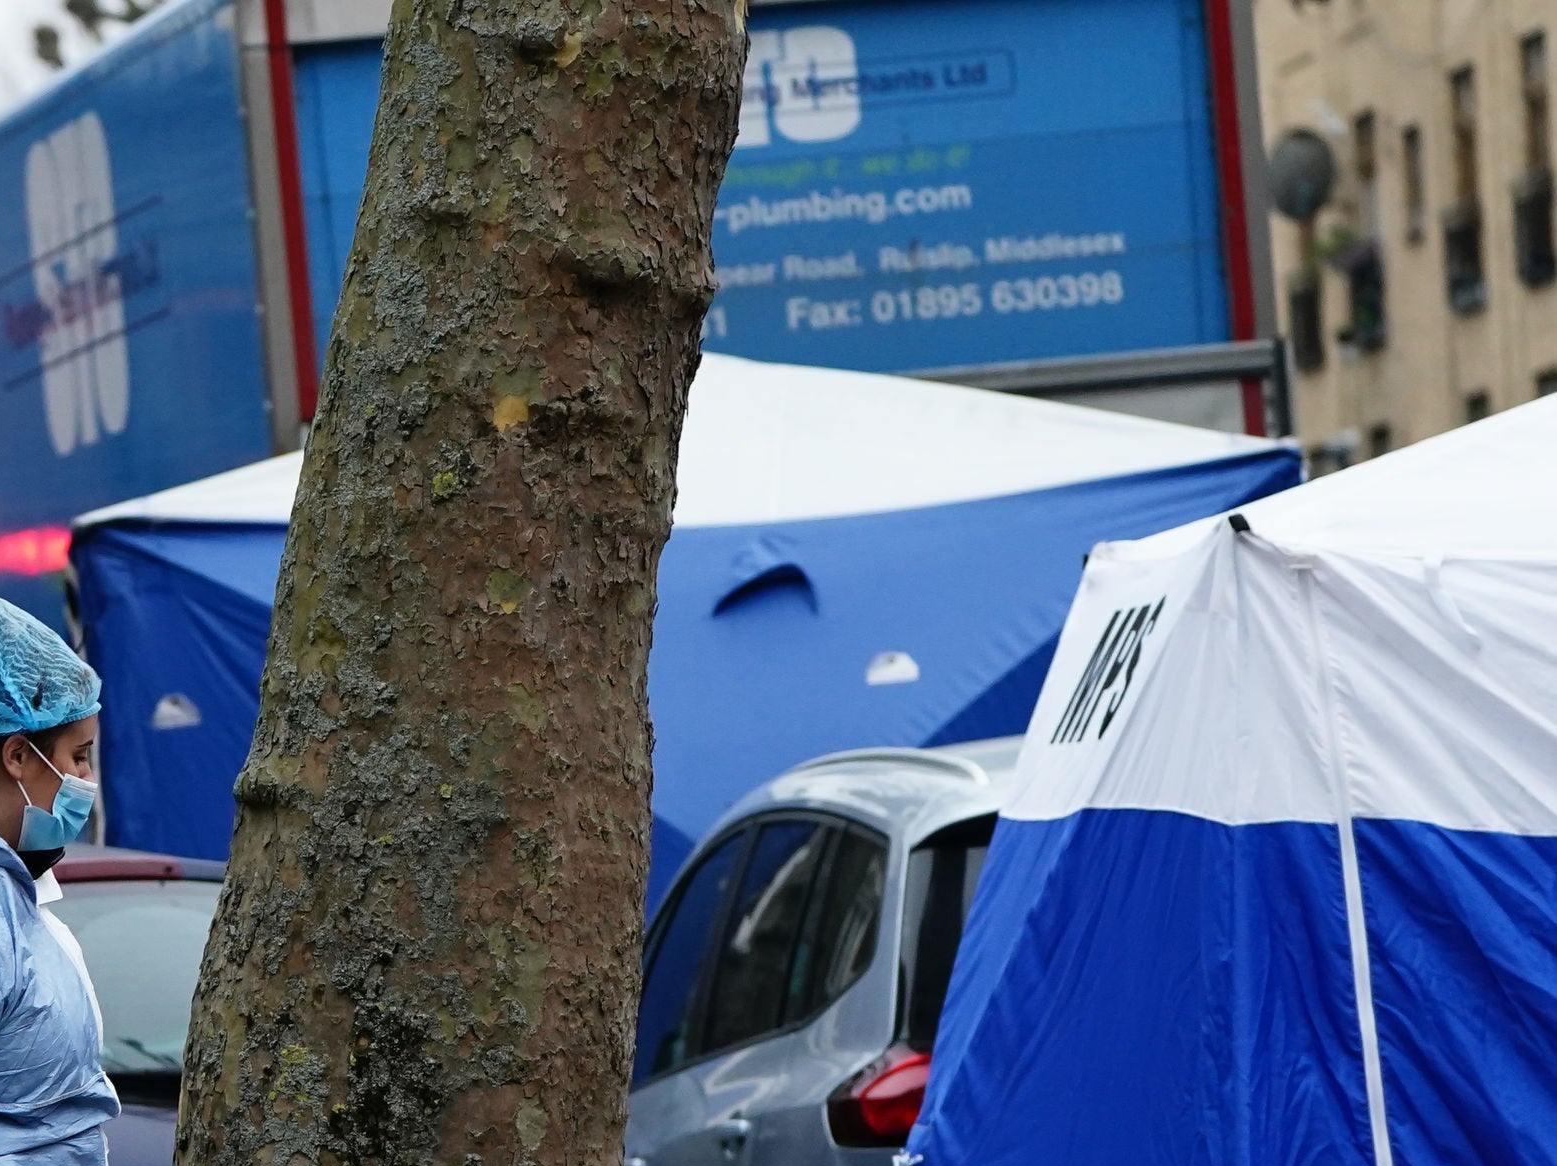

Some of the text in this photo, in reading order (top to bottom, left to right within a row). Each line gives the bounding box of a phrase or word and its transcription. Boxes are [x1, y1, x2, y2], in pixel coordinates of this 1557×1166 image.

[791, 67, 935, 98] Merchants
[943, 60, 989, 88] Ltd
[984, 231, 1125, 264] Middlesex
[786, 296, 863, 331] Fax:
[870, 281, 983, 323] 01895
[991, 269, 1125, 314] 630398
[1049, 593, 1168, 745] MPS
